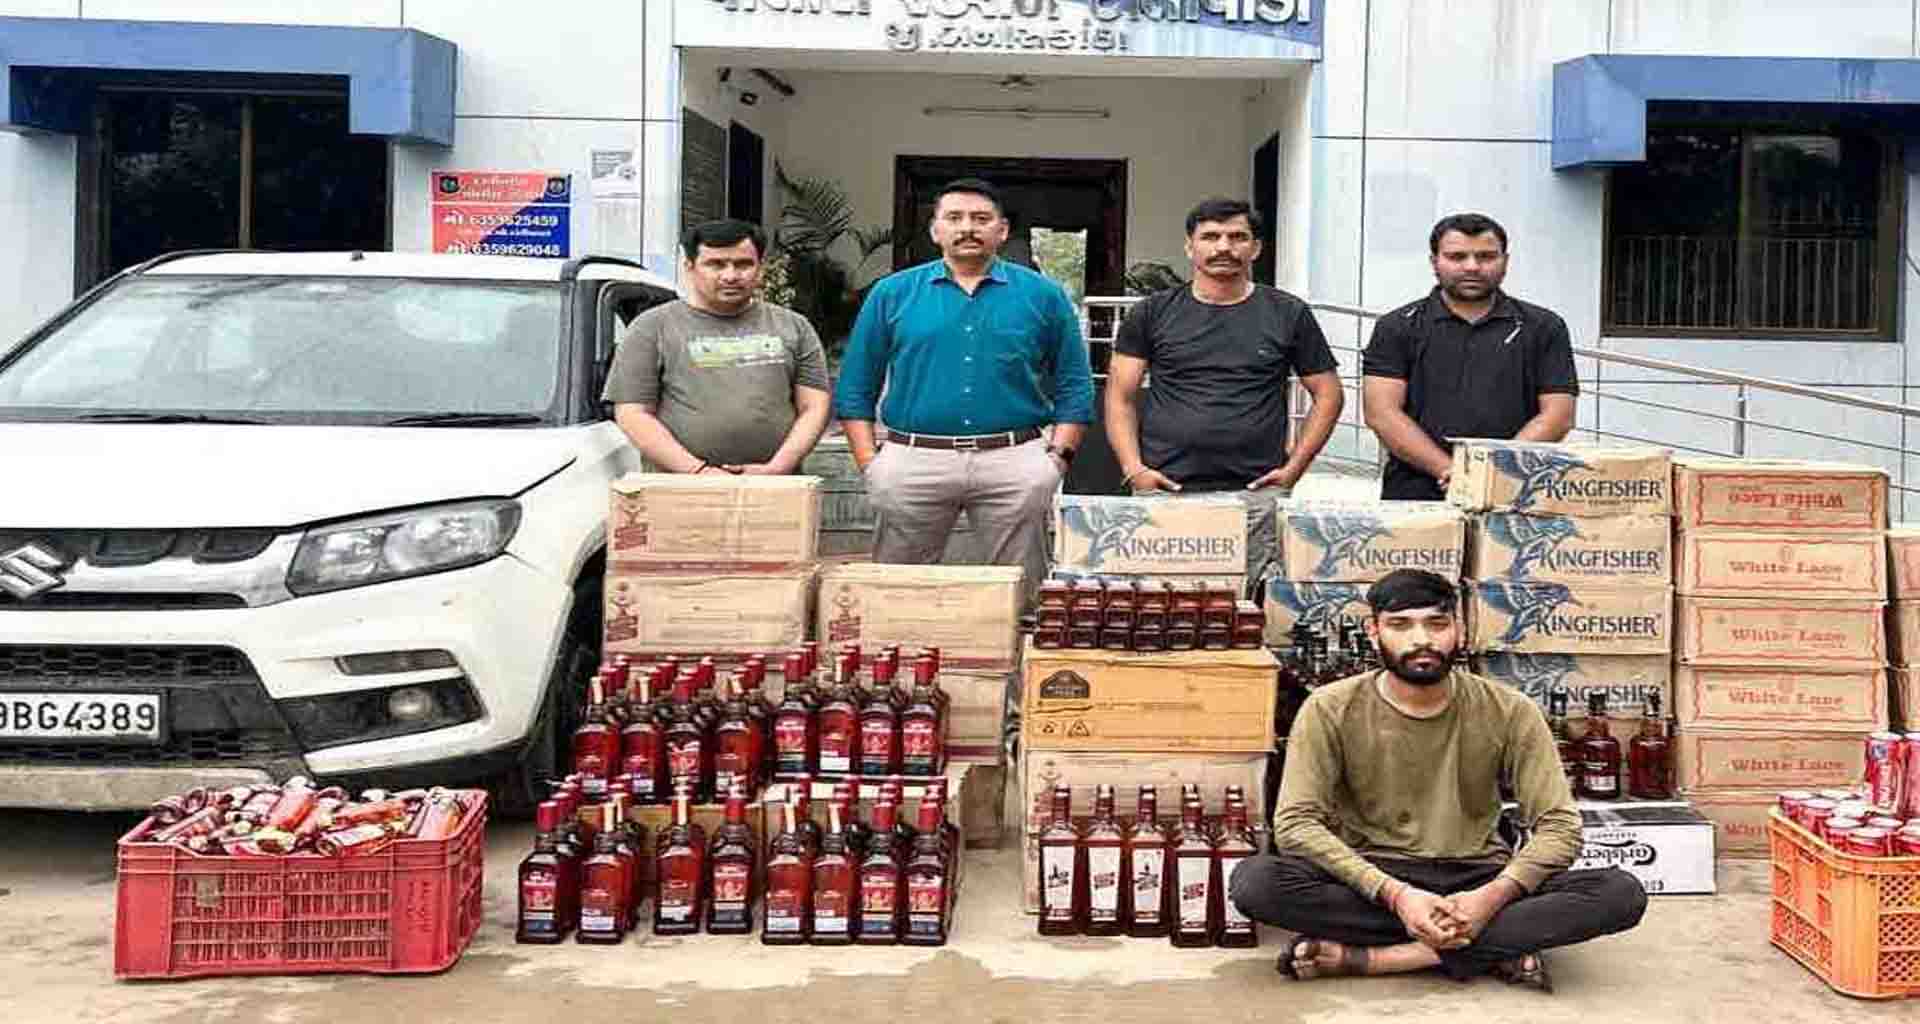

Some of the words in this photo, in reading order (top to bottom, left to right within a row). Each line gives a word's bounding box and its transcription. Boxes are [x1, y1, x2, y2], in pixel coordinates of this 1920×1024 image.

[1545, 477, 1664, 500] KINGFISHER
[1114, 534, 1236, 560] KINGFISHER
[1540, 547, 1661, 570] KINGFISHER
[1728, 560, 1790, 574] White
[1796, 561, 1844, 574] Lace
[1534, 612, 1658, 636] KINGFISHER
[1730, 628, 1792, 641] White
[1728, 687, 1791, 704] White
[1729, 759, 1793, 771] White
[1725, 822, 1769, 838] Whit
[1583, 843, 1657, 867] Carlsber
